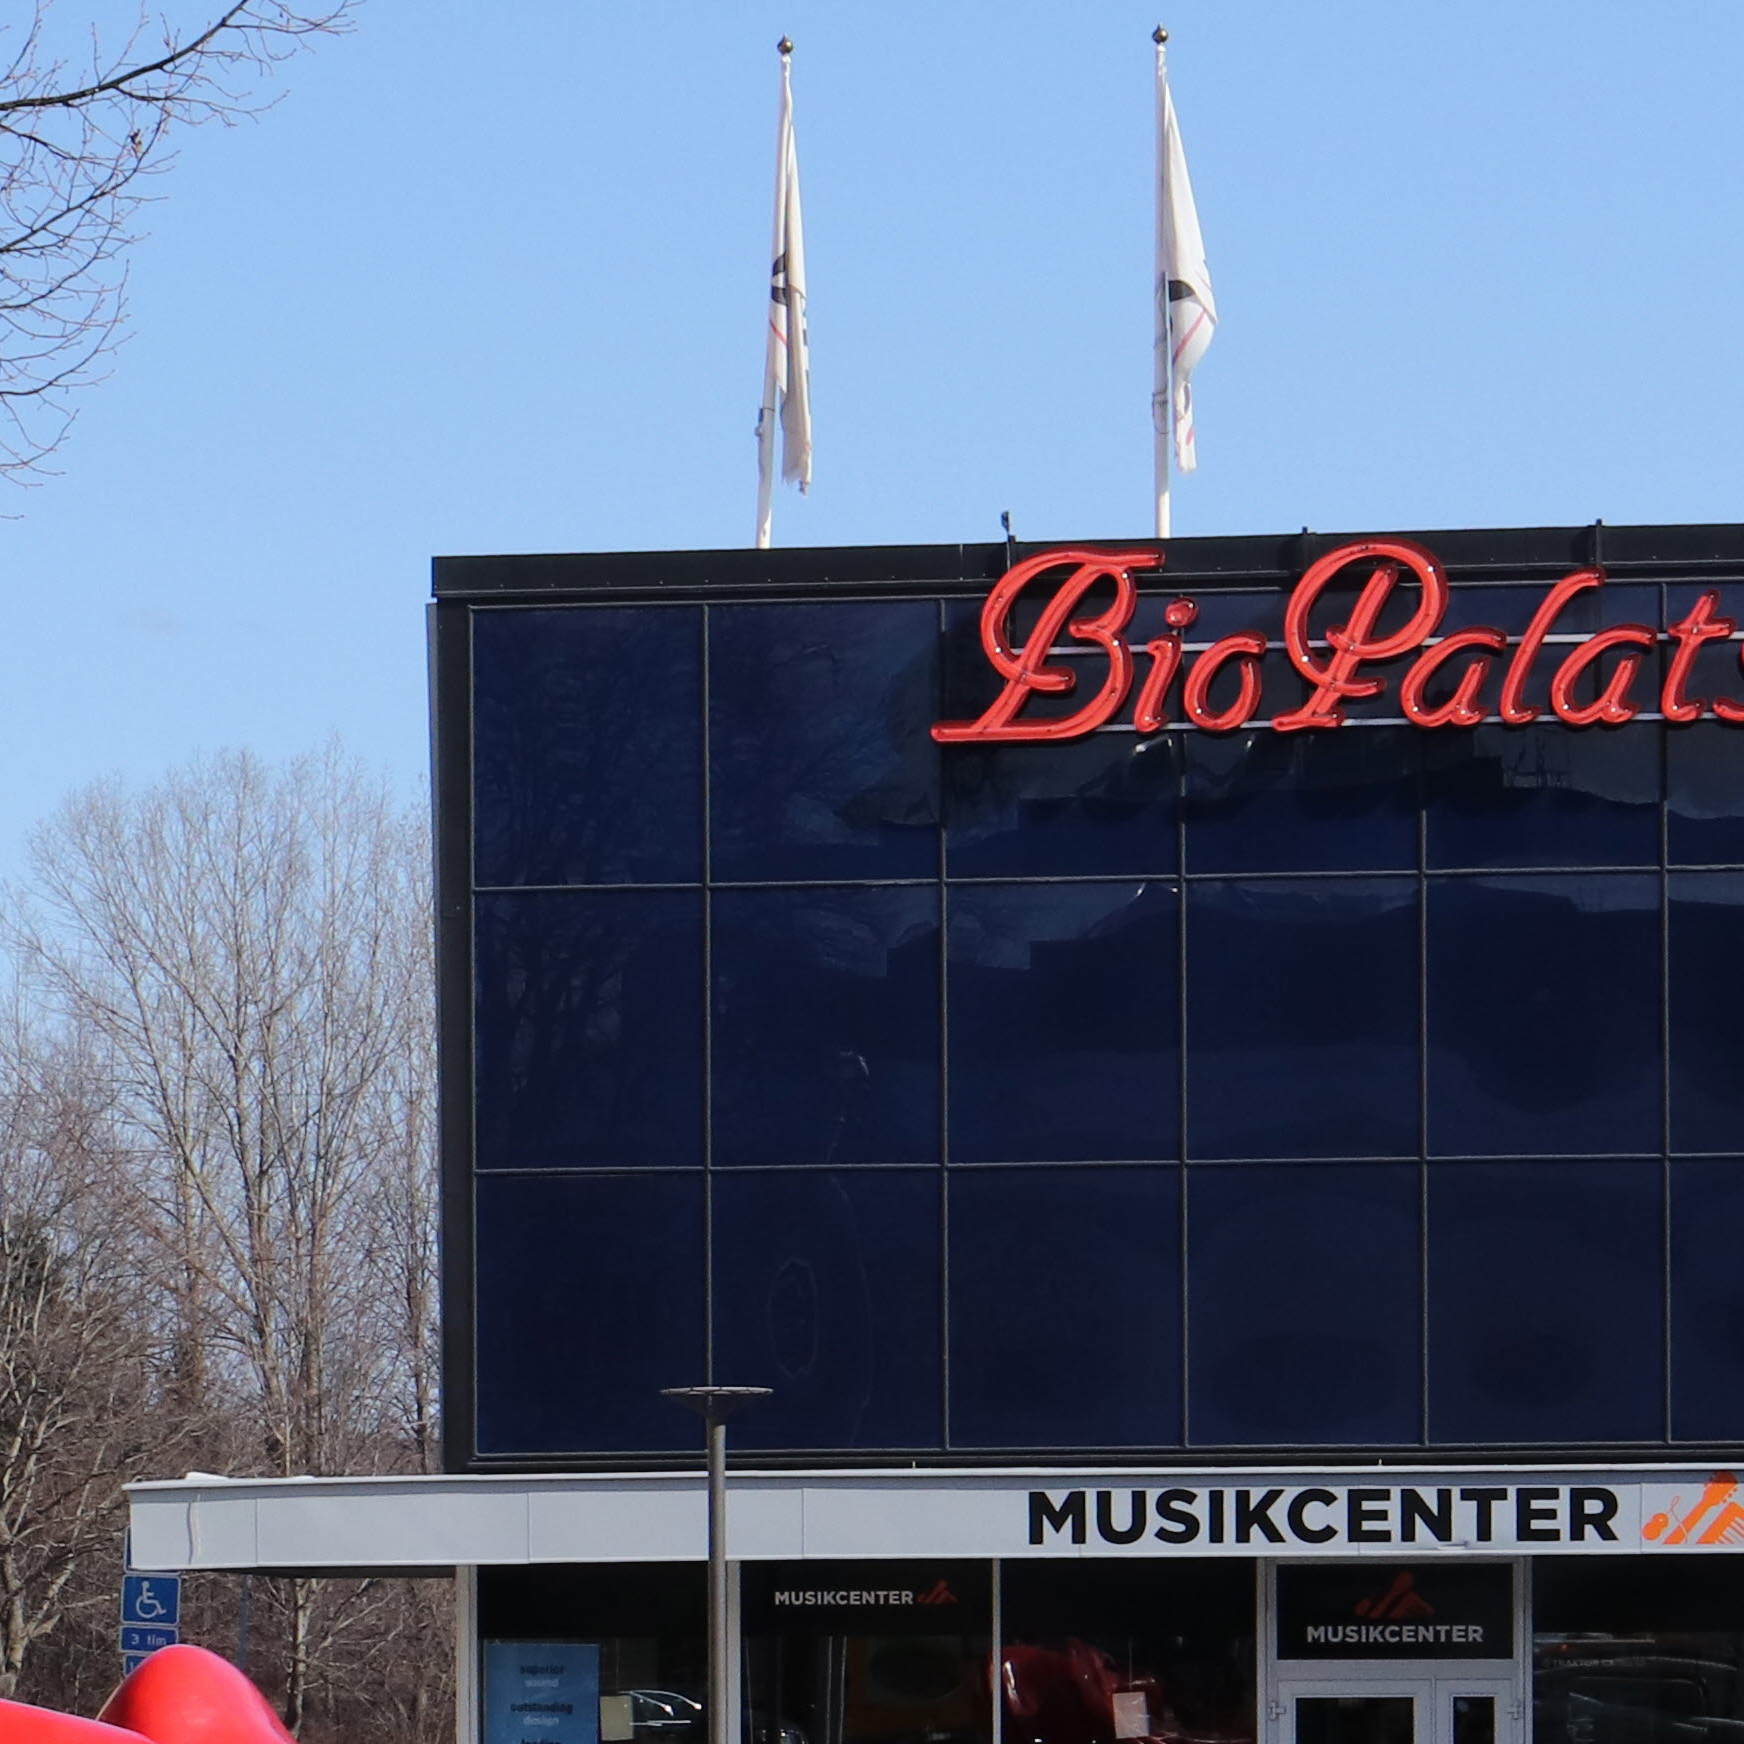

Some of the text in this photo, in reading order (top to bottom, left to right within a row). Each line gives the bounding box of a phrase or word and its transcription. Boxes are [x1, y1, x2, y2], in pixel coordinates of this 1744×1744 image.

[929, 546, 1268, 743] Bio
[1028, 1487, 1619, 1545] MUSIKCENTER
[775, 1591, 914, 1605] MUSIKCENTER
[131, 1634, 167, 1646] 3 tim
[1307, 1626, 1484, 1642] MUSIKCENTER
